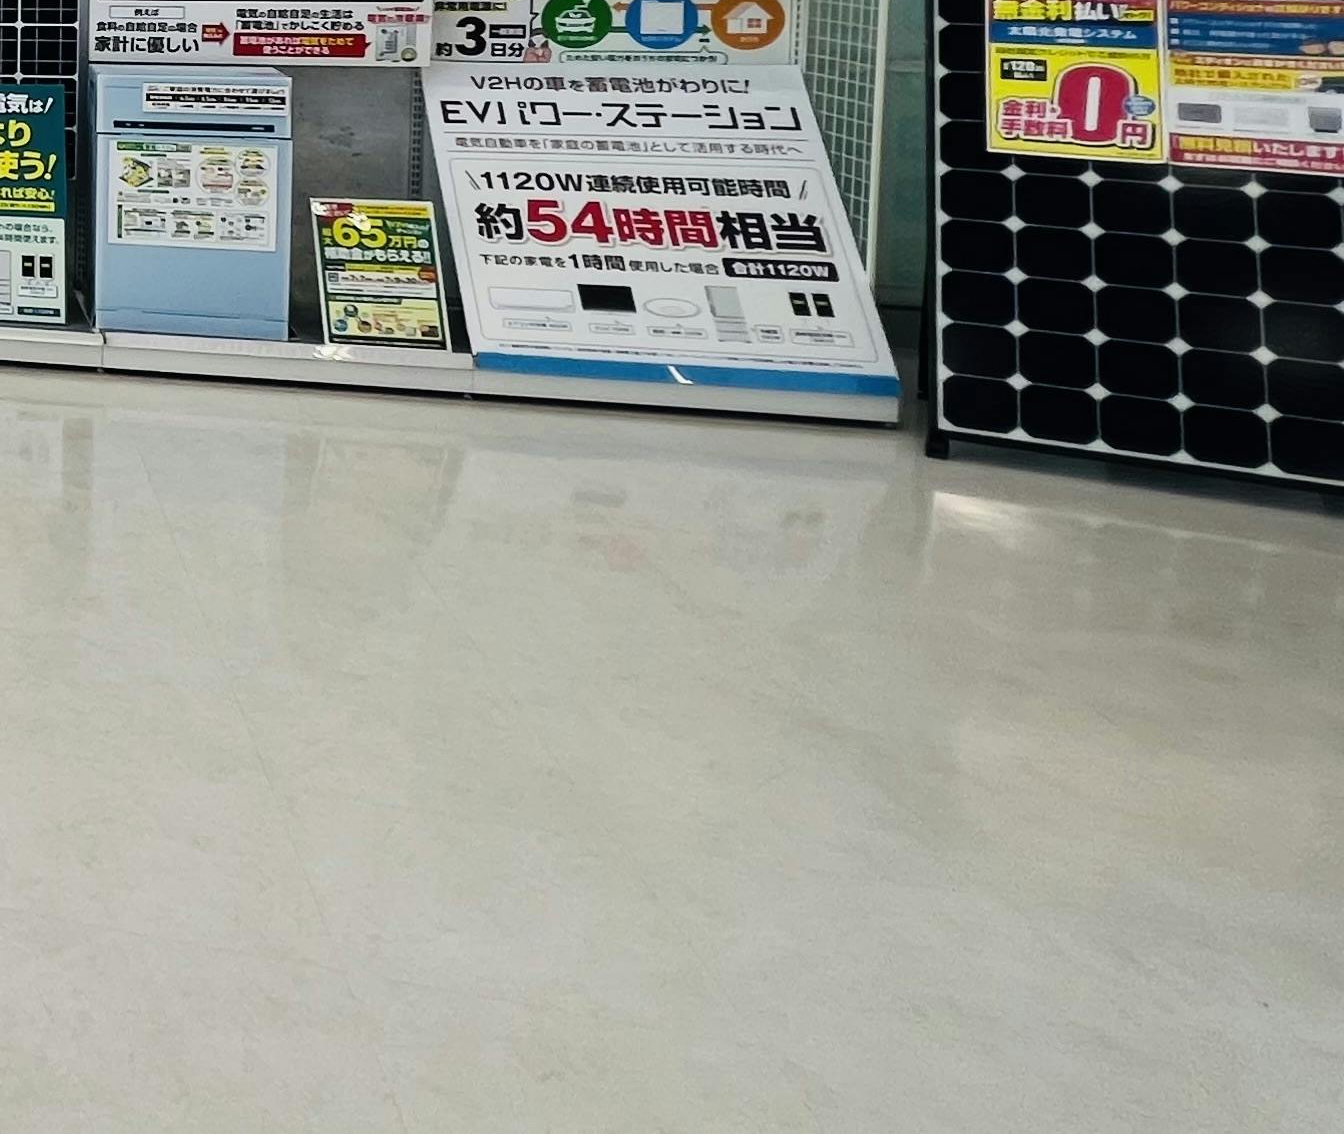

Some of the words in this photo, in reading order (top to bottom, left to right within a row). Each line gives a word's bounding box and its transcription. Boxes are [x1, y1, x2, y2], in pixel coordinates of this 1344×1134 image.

[134, 8, 160, 17] 例えば
[94, 36, 200, 54] 家計に優しい
[471, 74, 751, 95] V2Hの車を蓄電池がわりに!
[455, 137, 802, 156] 電気自動車を「家庭の蓄電池」として活用する時代へ
[480, 171, 792, 200] 1120W連続使用可能時間
[475, 198, 828, 254] 約54時間相当
[731, 259, 830, 280] 合計1120W
